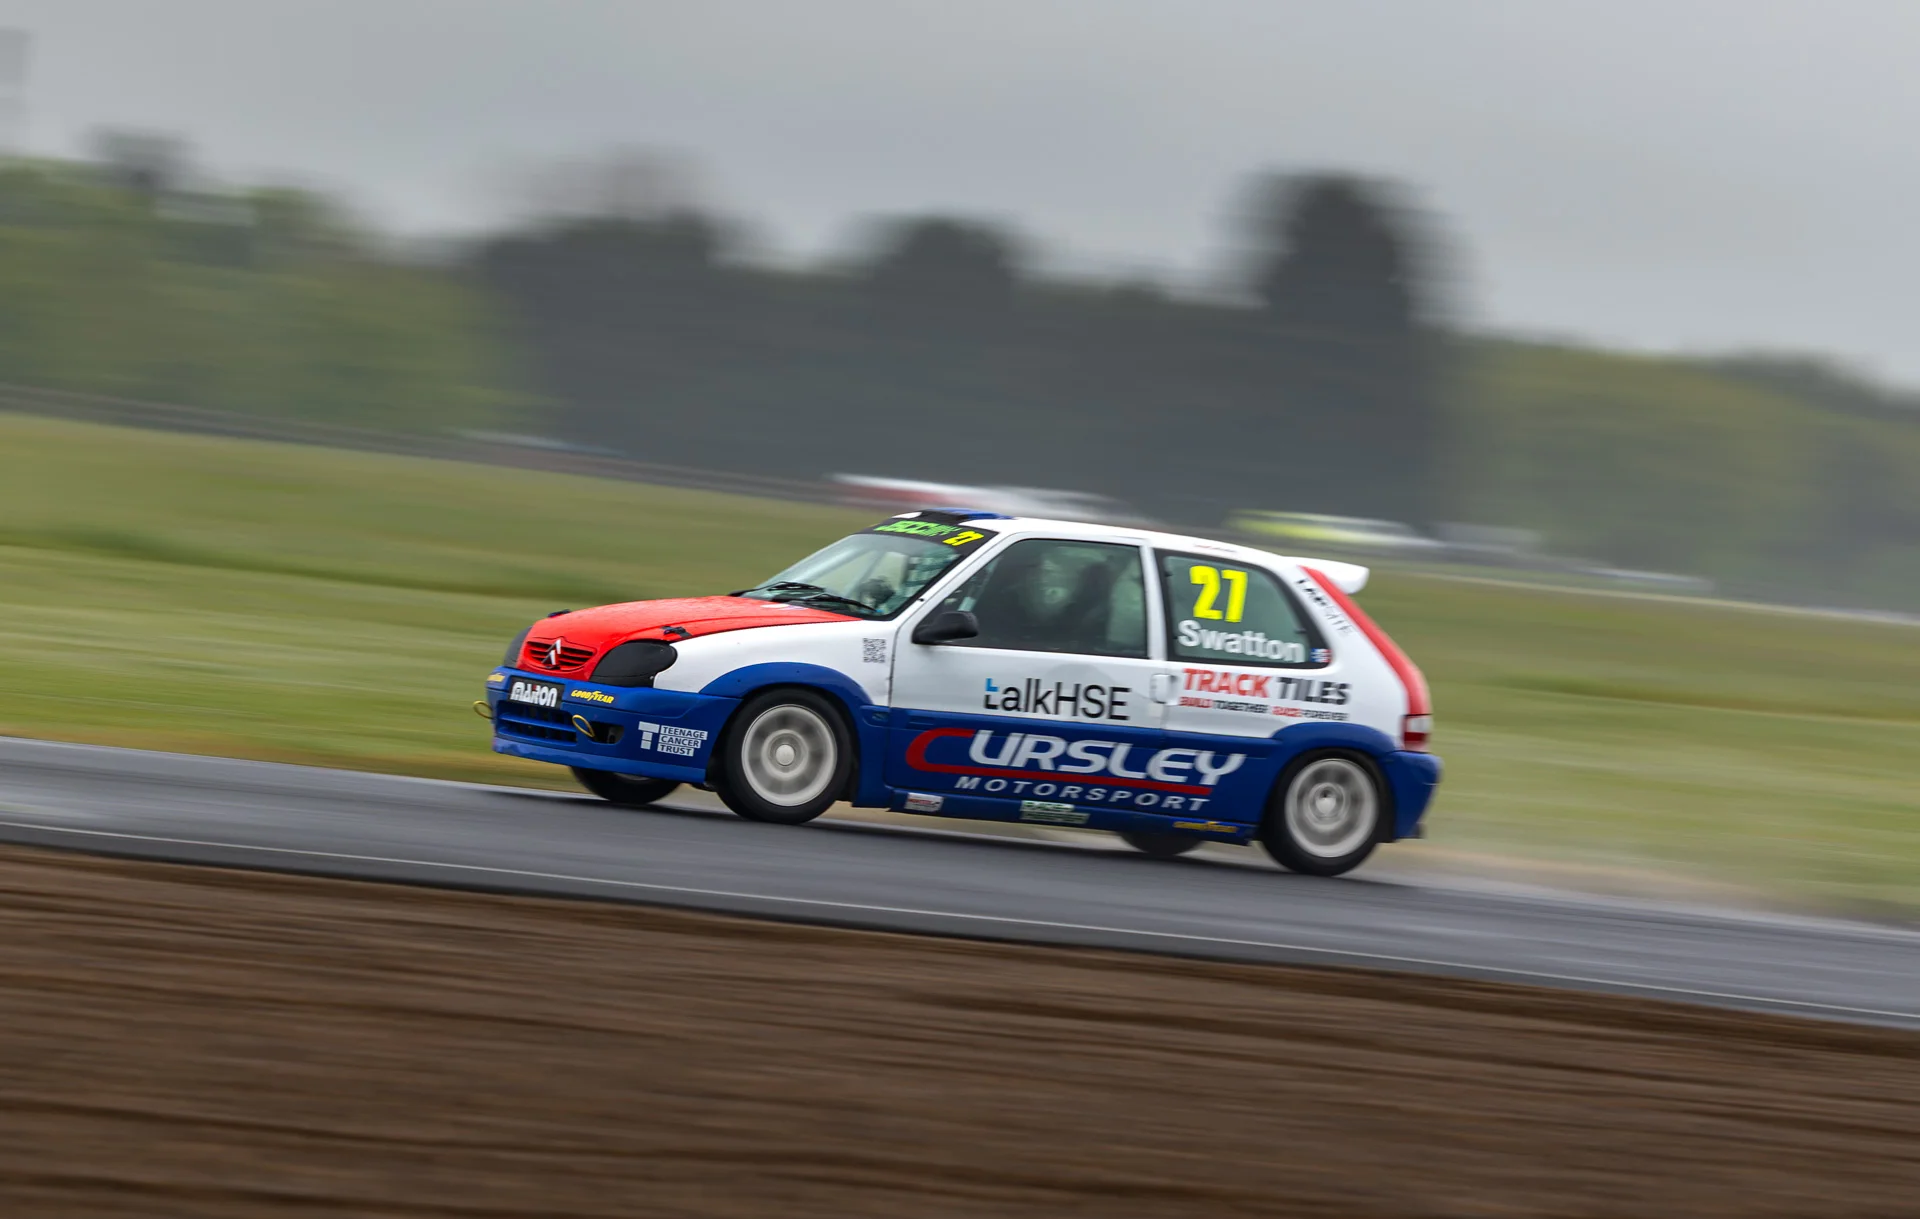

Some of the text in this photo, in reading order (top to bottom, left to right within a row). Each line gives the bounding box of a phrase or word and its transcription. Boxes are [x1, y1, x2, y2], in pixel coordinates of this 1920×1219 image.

[942, 530, 985, 546] 27
[1189, 565, 1248, 623] 27
[1178, 619, 1305, 663] Swatton
[571, 689, 614, 704] GOODYEAR
[1182, 668, 1351, 706] TRACK TILES
[660, 735, 701, 748] CANCER
[662, 726, 706, 739] TEENAGE
[658, 744, 692, 756] TRUST
[905, 727, 1247, 792] CURSLEY
[954, 776, 1211, 811] MOTORSPORT
